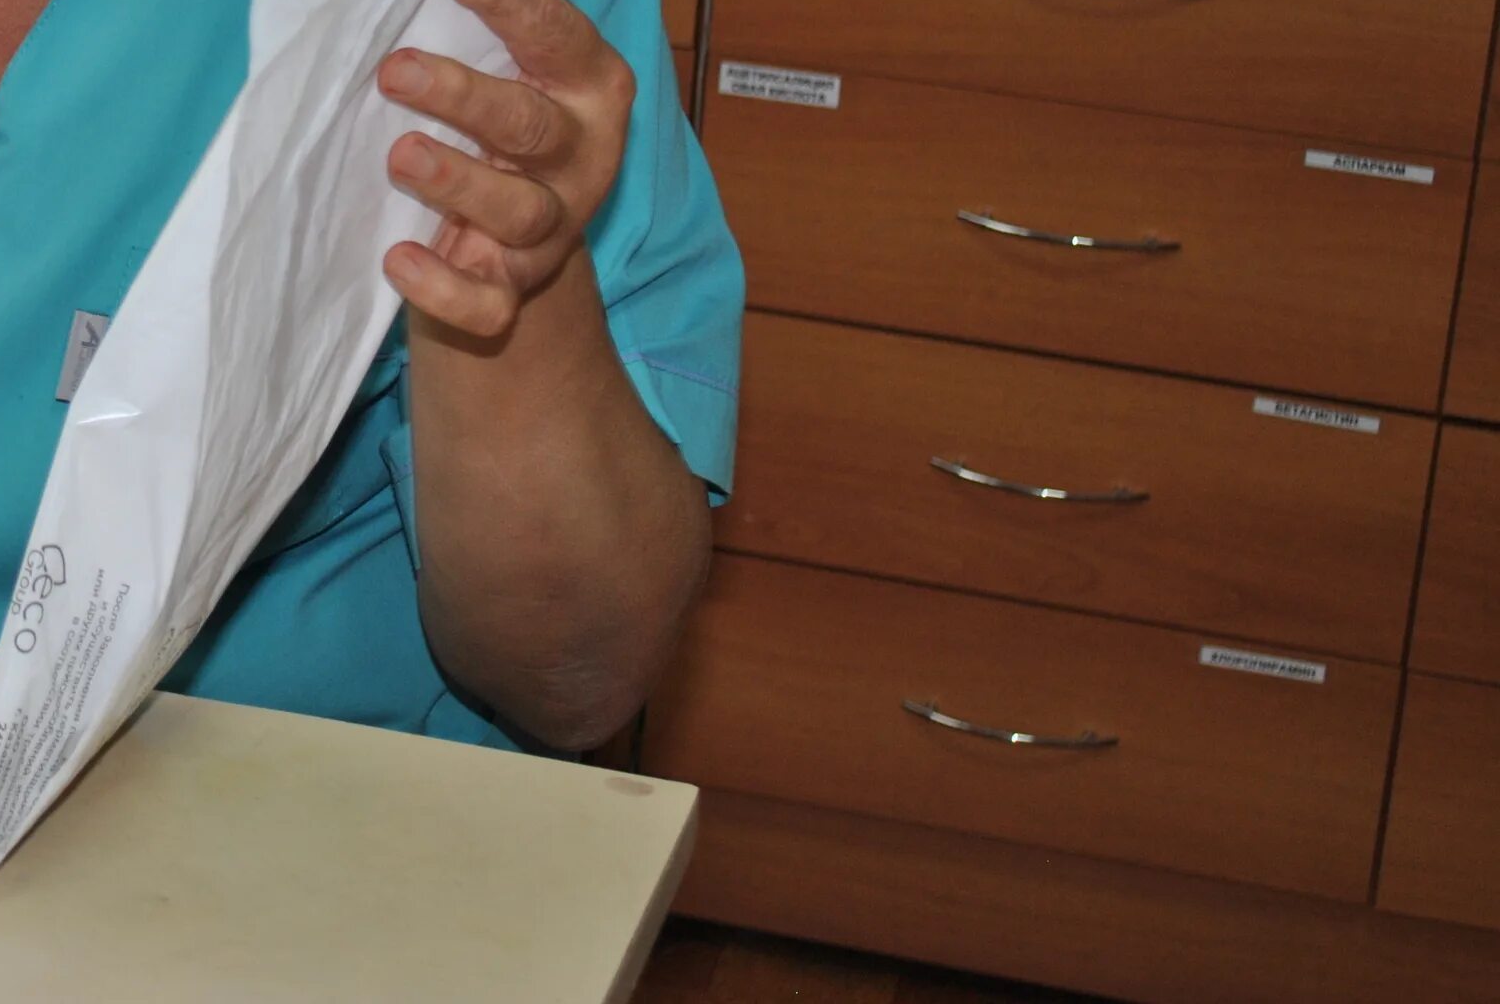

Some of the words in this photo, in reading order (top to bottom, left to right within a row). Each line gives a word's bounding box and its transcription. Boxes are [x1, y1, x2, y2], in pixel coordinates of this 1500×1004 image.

[11, 549, 46, 616] Group
[93, 568, 105, 598] или
[109, 582, 132, 632] После
